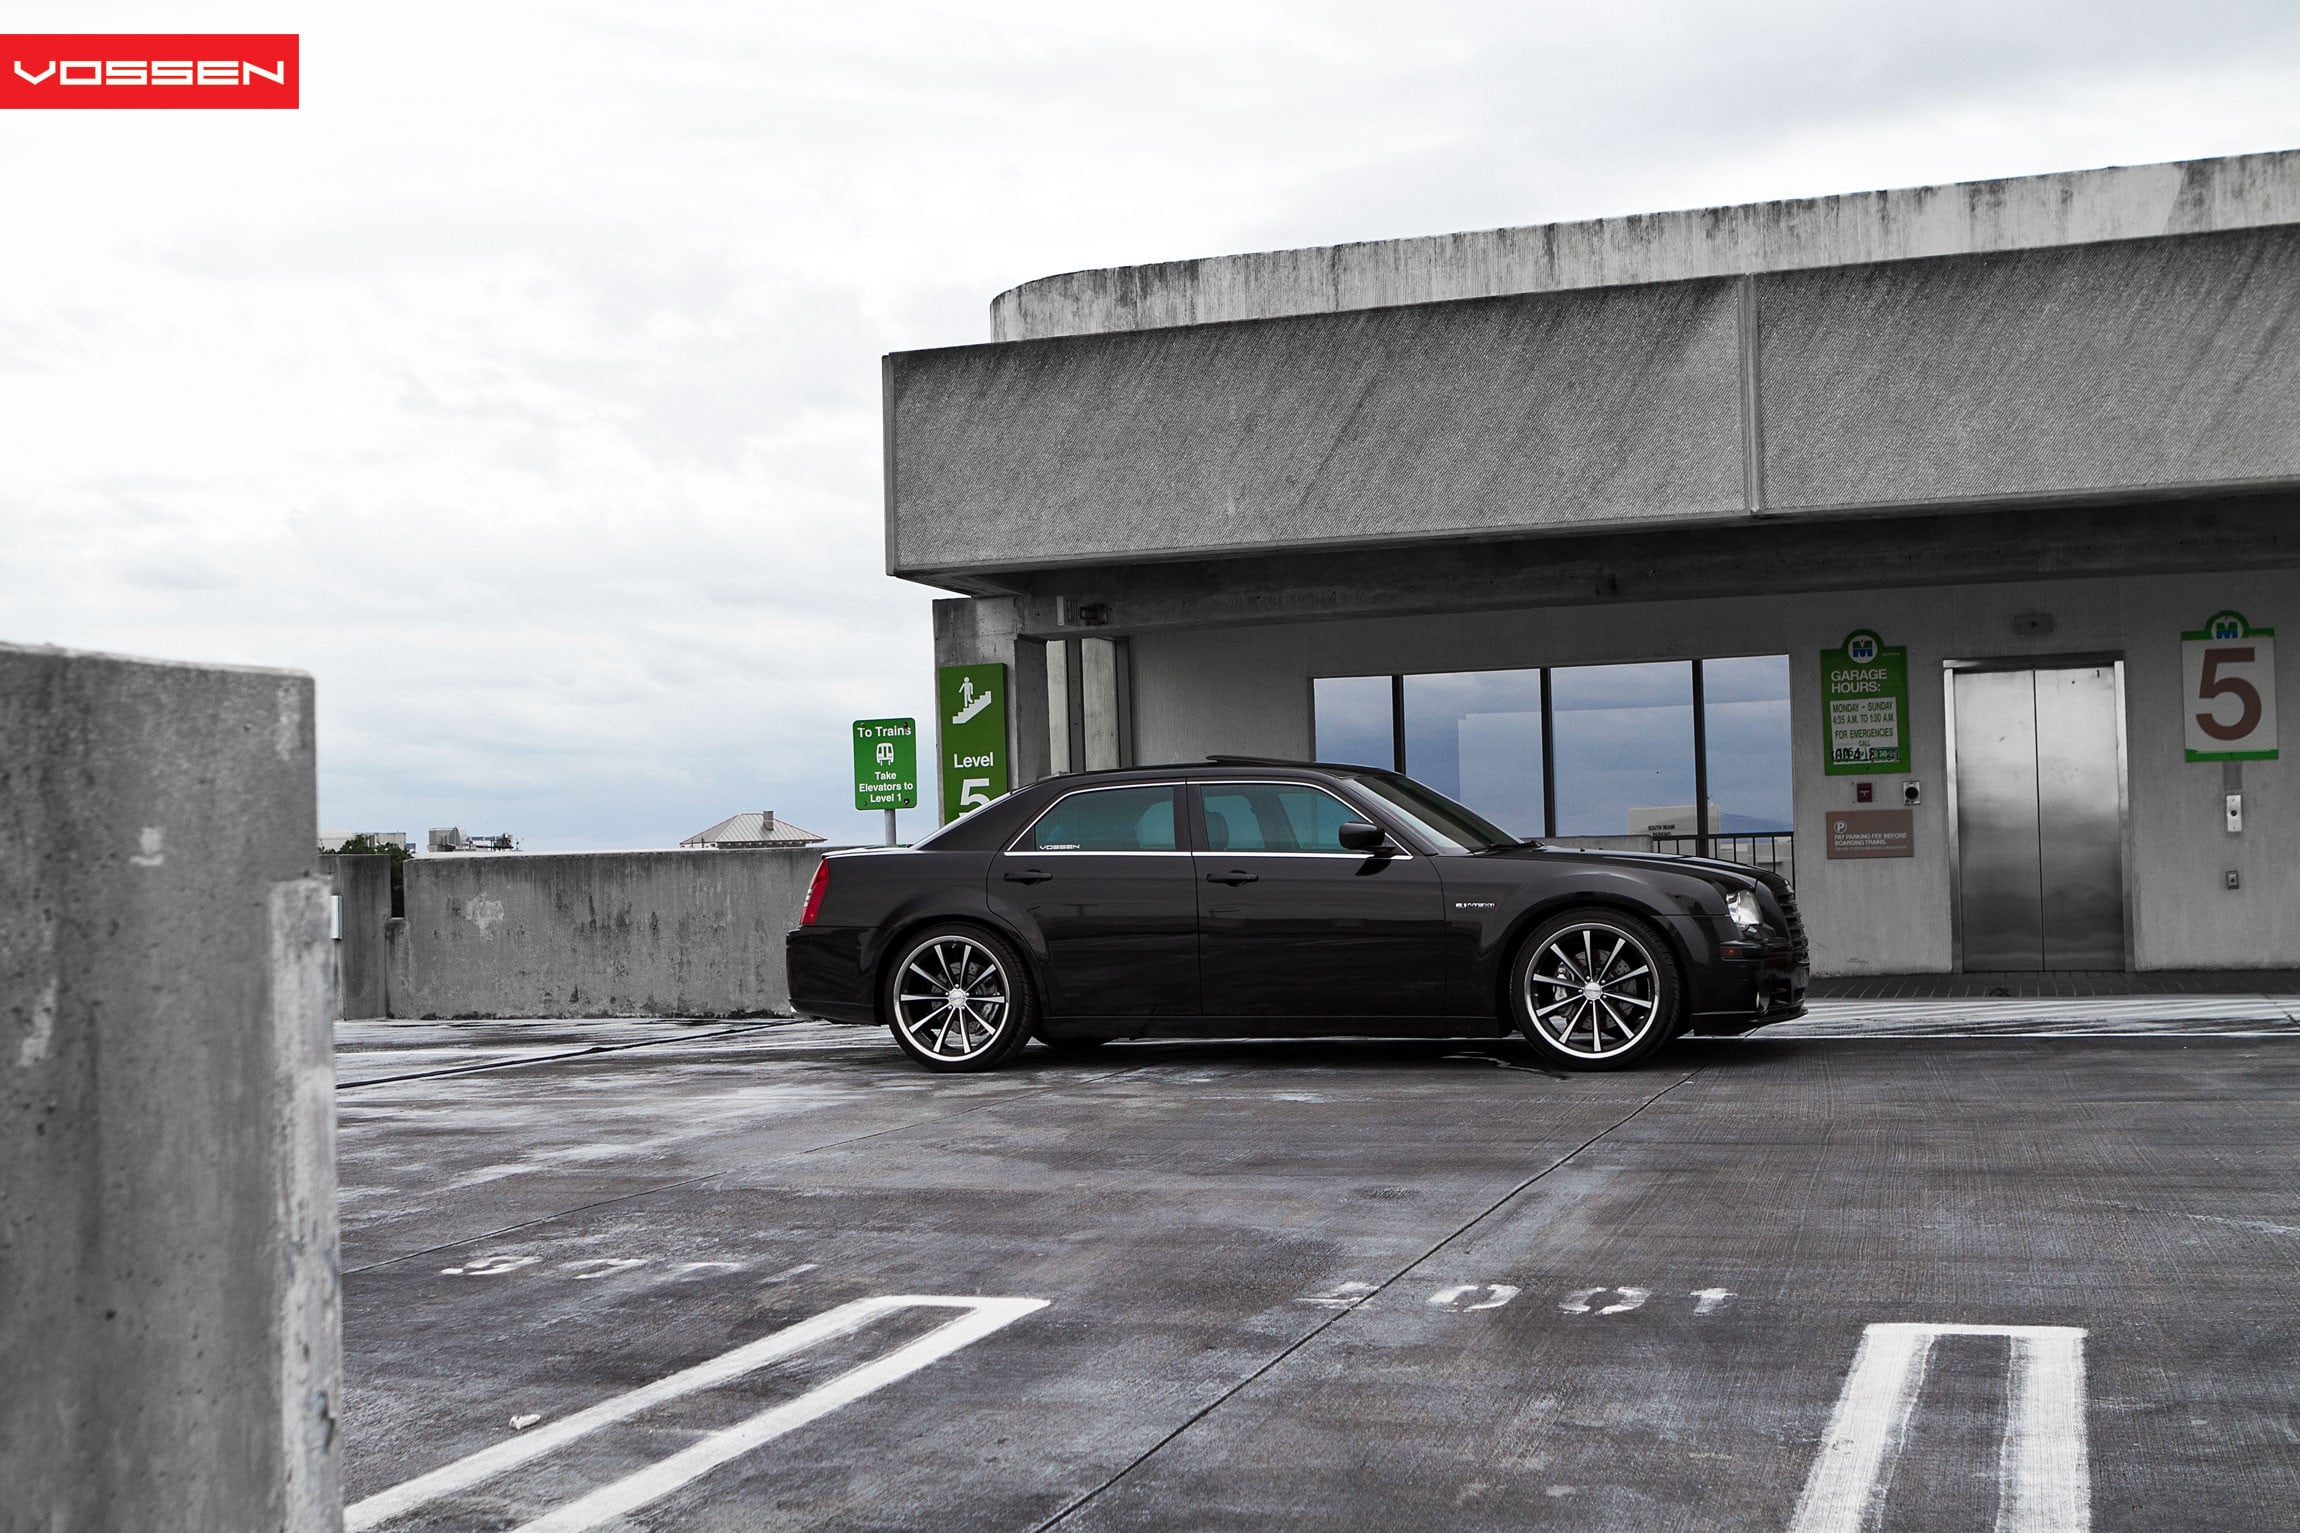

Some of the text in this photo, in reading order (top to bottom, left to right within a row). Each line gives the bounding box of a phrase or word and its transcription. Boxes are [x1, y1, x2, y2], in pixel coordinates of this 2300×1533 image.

[1830, 669, 1887, 681] GARAGE
[1831, 682, 1881, 693] HOURS:
[2195, 647, 2262, 741] 5
[1832, 704, 1859, 713] MONDAY
[1867, 702, 1893, 711] SUNDAY
[1861, 714, 1869, 723] TO
[857, 725, 912, 738] To Trains
[1835, 728, 1894, 739] FOR EMERGENCIES
[953, 752, 994, 768] Level
[874, 771, 897, 780] Take
[859, 782, 914, 792] Elevators to
[870, 793, 895, 803] Level
[959, 777, 991, 818] 5
